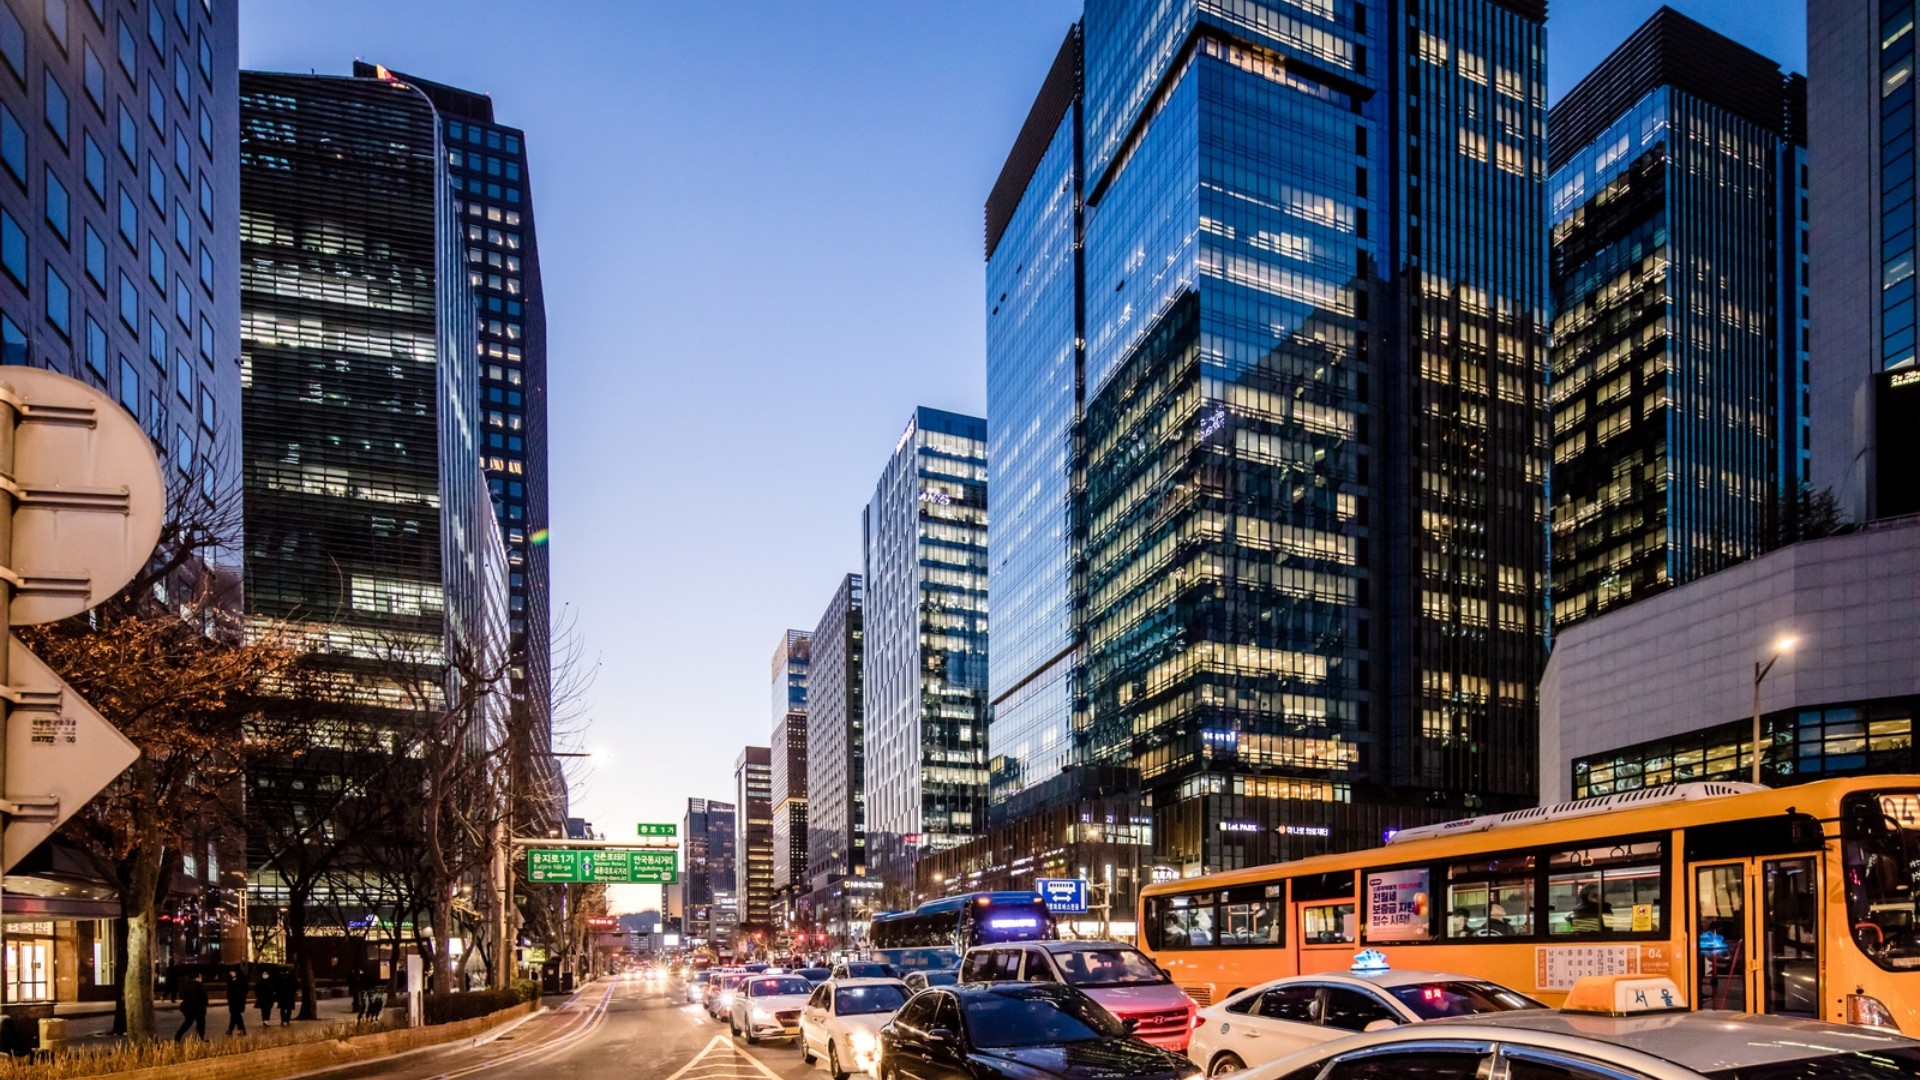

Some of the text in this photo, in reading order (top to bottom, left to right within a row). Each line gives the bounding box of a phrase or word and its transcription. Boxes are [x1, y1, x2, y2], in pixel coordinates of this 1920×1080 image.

[1882, 797, 1915, 825] 04
[1240, 823, 1257, 832] PARK
[533, 853, 574, 864] 을지로1가
[633, 855, 673, 865] 안국동사거리
[1373, 891, 1397, 903] 전월세
[1373, 902, 1397, 914] 보증금
[1648, 949, 1662, 959] 04
[1635, 988, 1674, 1007] 서울
